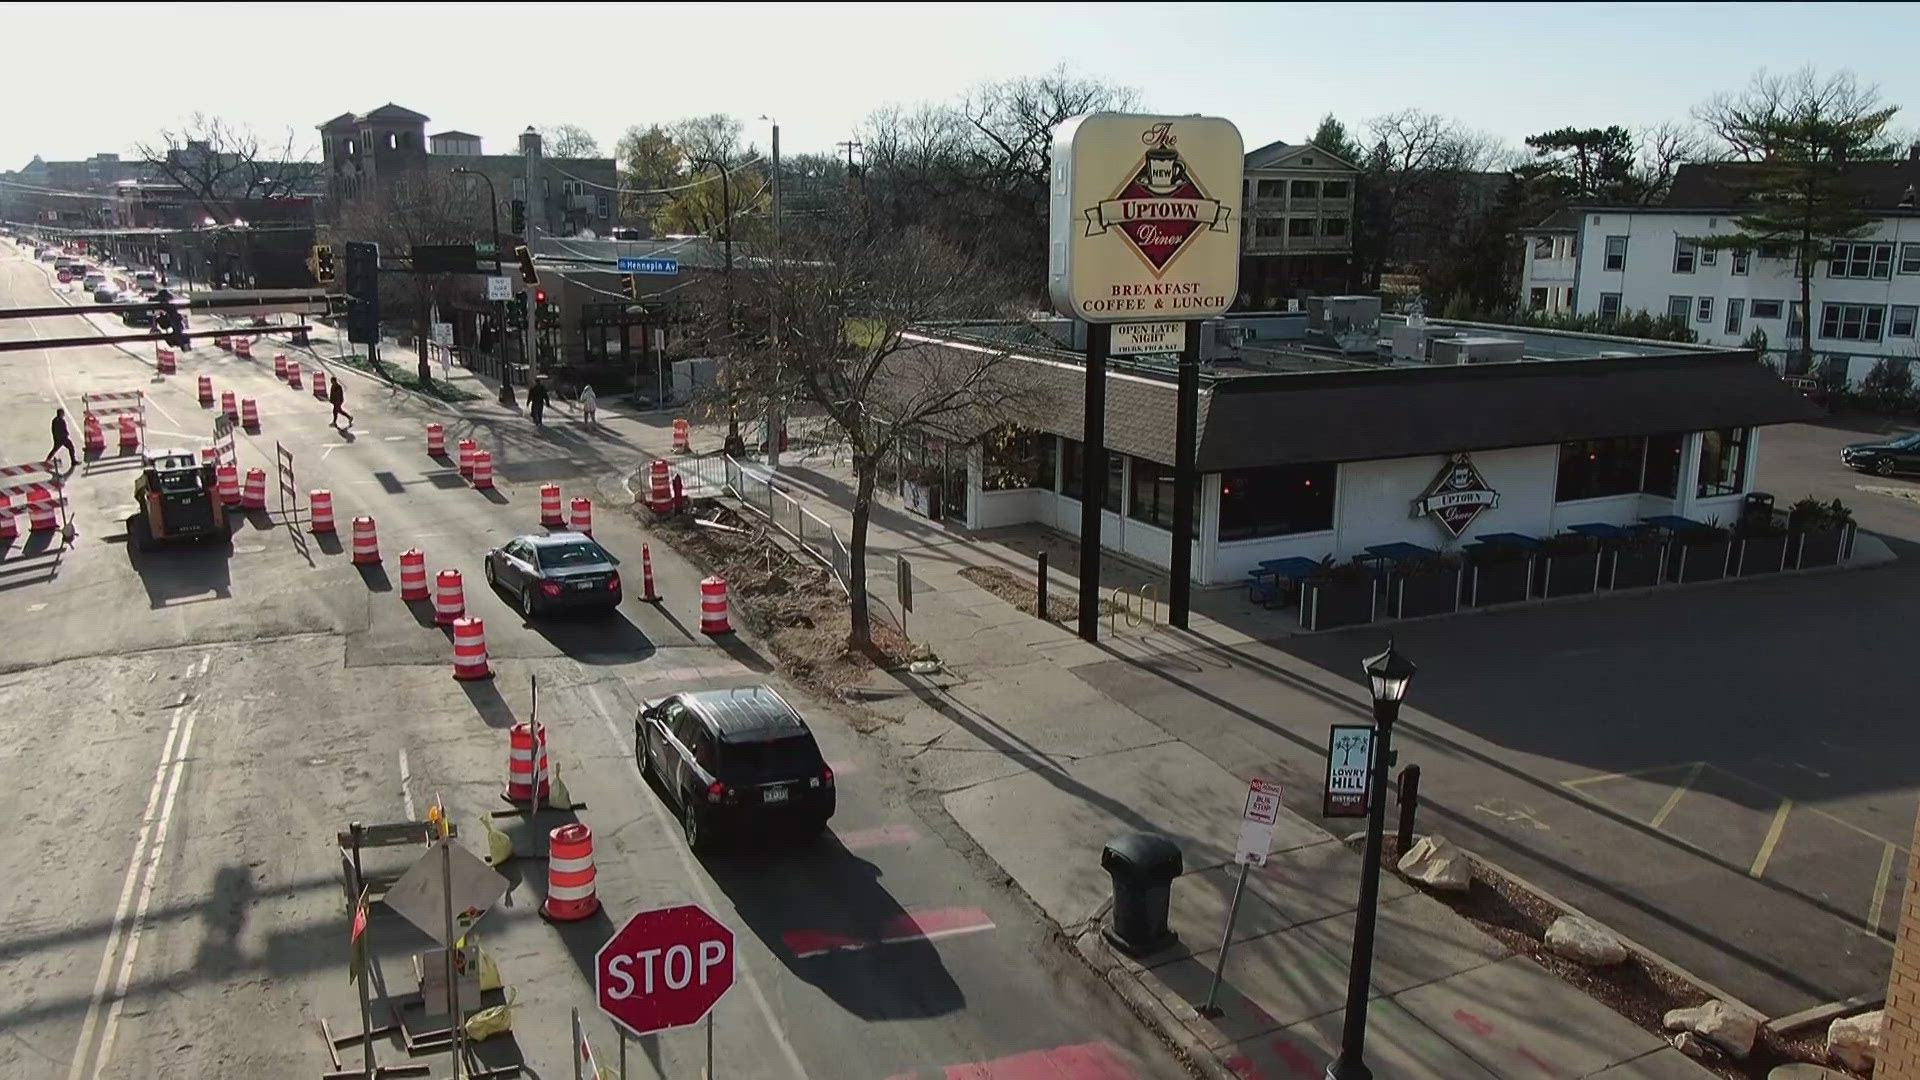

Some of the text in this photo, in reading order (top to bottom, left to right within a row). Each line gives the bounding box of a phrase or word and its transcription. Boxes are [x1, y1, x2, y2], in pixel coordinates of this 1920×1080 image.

[1141, 122, 1177, 146] The
[1152, 168, 1172, 178] NEW
[1122, 201, 1199, 219] UPTOWN
[1137, 223, 1182, 246] Diner
[627, 261, 676, 272] Hennepin Av
[1112, 283, 1200, 296] BREAKFAST
[1082, 296, 1225, 312] COFFEE & LUNCH
[1118, 323, 1179, 334] OPEN LATE
[1131, 333, 1165, 343] NIGHT
[1442, 493, 1481, 505] UPTOWN
[1332, 769, 1364, 777] LOWRY
[1332, 777, 1363, 789] HILL
[608, 940, 726, 1000] STOP
